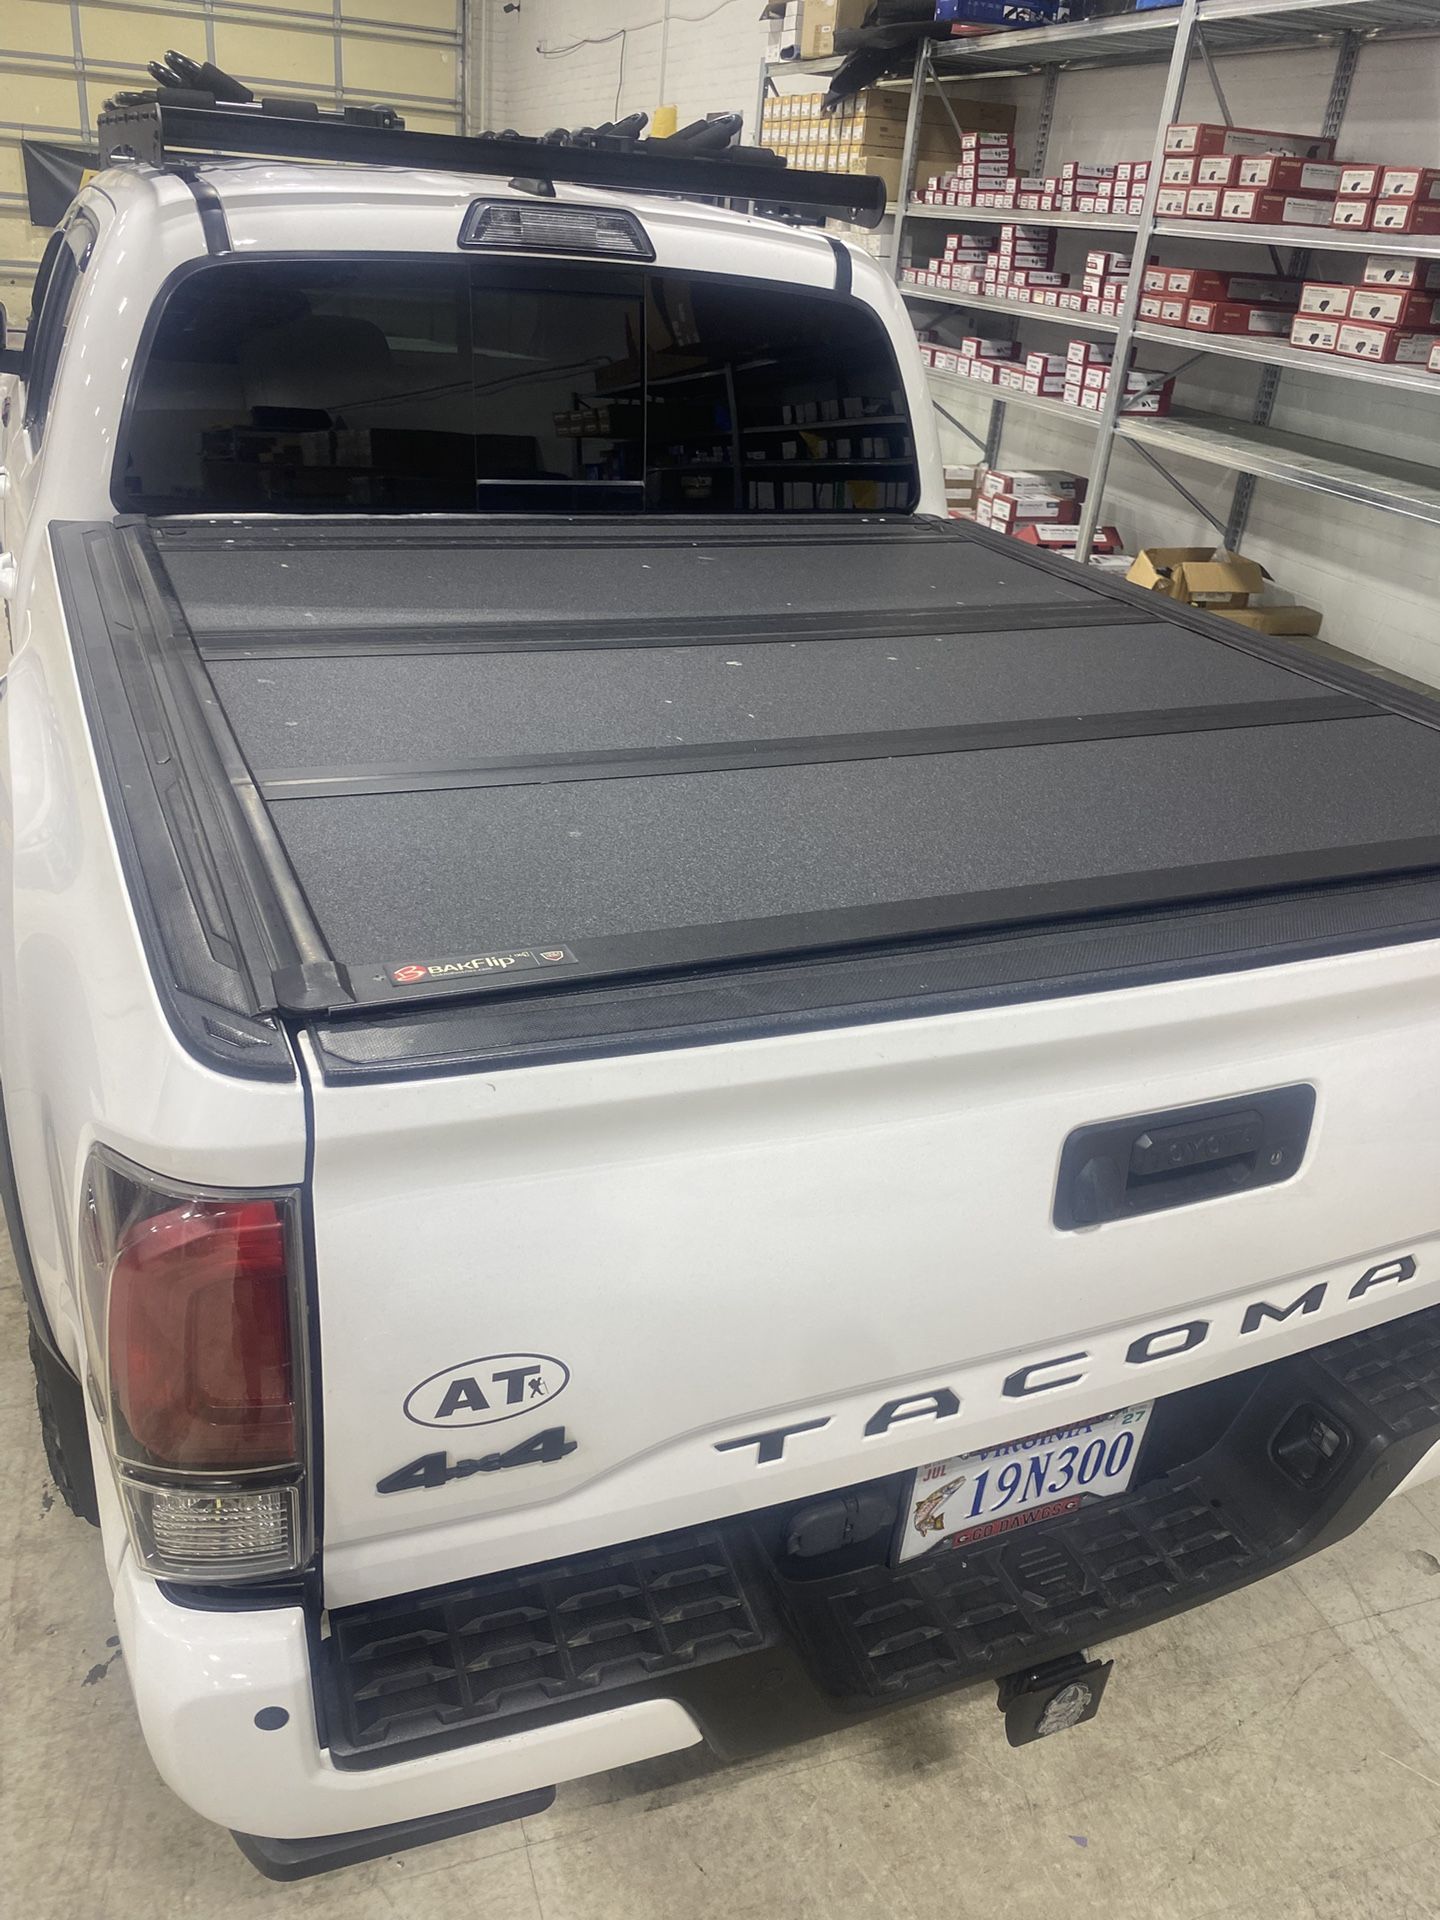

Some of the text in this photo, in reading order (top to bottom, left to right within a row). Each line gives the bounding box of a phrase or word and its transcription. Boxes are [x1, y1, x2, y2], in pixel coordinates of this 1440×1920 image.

[713, 1253, 1419, 1466] TACOMA
[434, 1365, 541, 1418] AT
[1122, 1410, 1146, 1425] 27
[376, 1426, 578, 1494] 4x4
[923, 1465, 947, 1482] JUL
[964, 1431, 1135, 1519] 19N300
